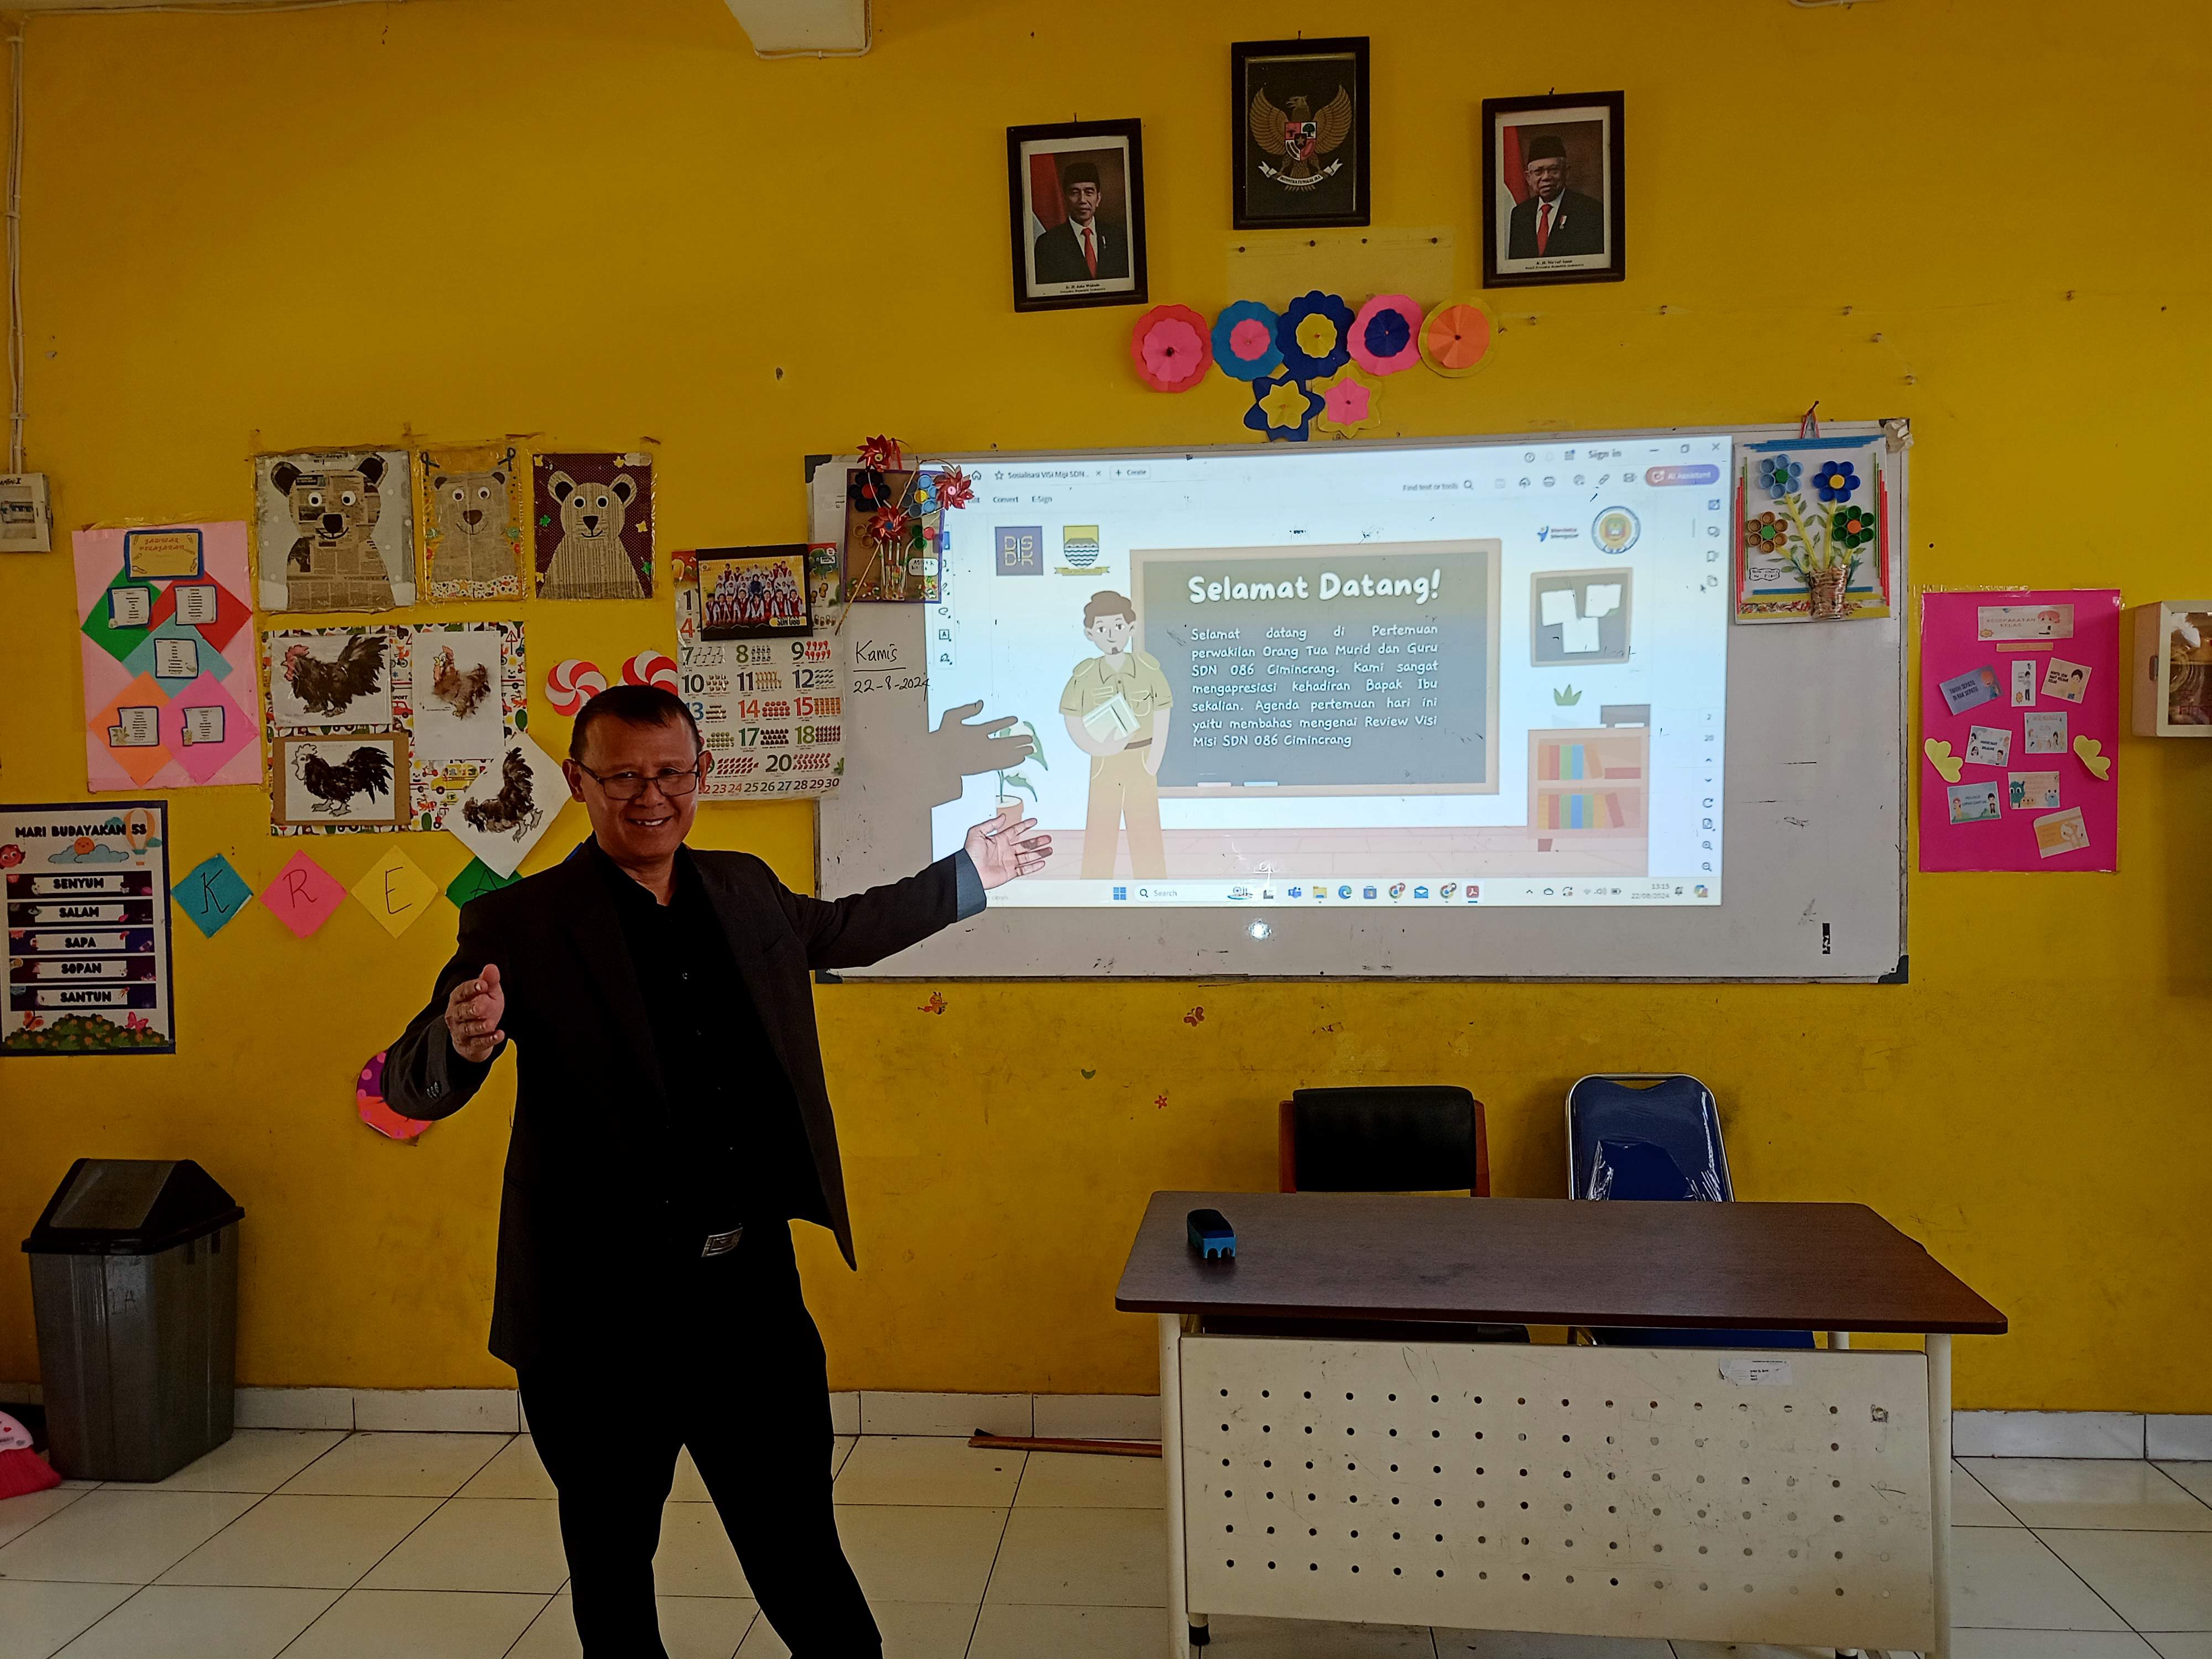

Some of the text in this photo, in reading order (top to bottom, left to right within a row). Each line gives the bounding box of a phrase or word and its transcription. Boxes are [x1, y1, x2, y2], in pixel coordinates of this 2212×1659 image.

[1588, 448, 1621, 461] Sign in
[1402, 483, 1418, 492] Find
[1442, 482, 1458, 490] tools
[1188, 568, 1441, 605] Selamat Datang!
[684, 589, 692, 610] 1
[681, 618, 695, 638] 4
[1191, 625, 1438, 641] Selamat datang di Pertemuan
[681, 641, 805, 666] 7 8 9
[855, 640, 898, 664] Kamis
[1192, 643, 1438, 661] perwakilan Orang Tua Murid dan Guru
[1191, 660, 1438, 677] SDN 086 Cimincrang. Kami sangat
[681, 669, 815, 693] 10 11 12
[1192, 679, 1438, 697] mengapresiasi kehadiran Bapak Ibu
[737, 699, 760, 718] 14
[794, 697, 813, 716] 15
[1191, 697, 1438, 713] sekalian. Agenda pertemuan hari ini
[1192, 715, 1438, 733] yaitu membahas mengenai Review Visi
[738, 726, 815, 747] 17 18
[1193, 734, 1352, 748] Misi SDN 086 Cimincrang
[765, 754, 792, 773] 20
[712, 784, 727, 794] 23
[728, 783, 742, 793] 24
[744, 782, 759, 792] 25
[760, 781, 775, 792] 26
[777, 781, 792, 791] 27
[793, 780, 808, 790] 28
[809, 779, 825, 789] 29
[825, 778, 839, 788] 30
[15, 823, 147, 838] MARI BUDAYAKAN 5S
[53, 877, 105, 890] SENYUM
[200, 868, 230, 915] K
[283, 868, 317, 909] R
[384, 866, 413, 915] E
[1154, 889, 1177, 898] Search
[59, 907, 100, 919] SALAM
[64, 937, 97, 948] SAPA
[61, 963, 102, 975] SOPAN
[60, 991, 112, 1003] SANTUN
